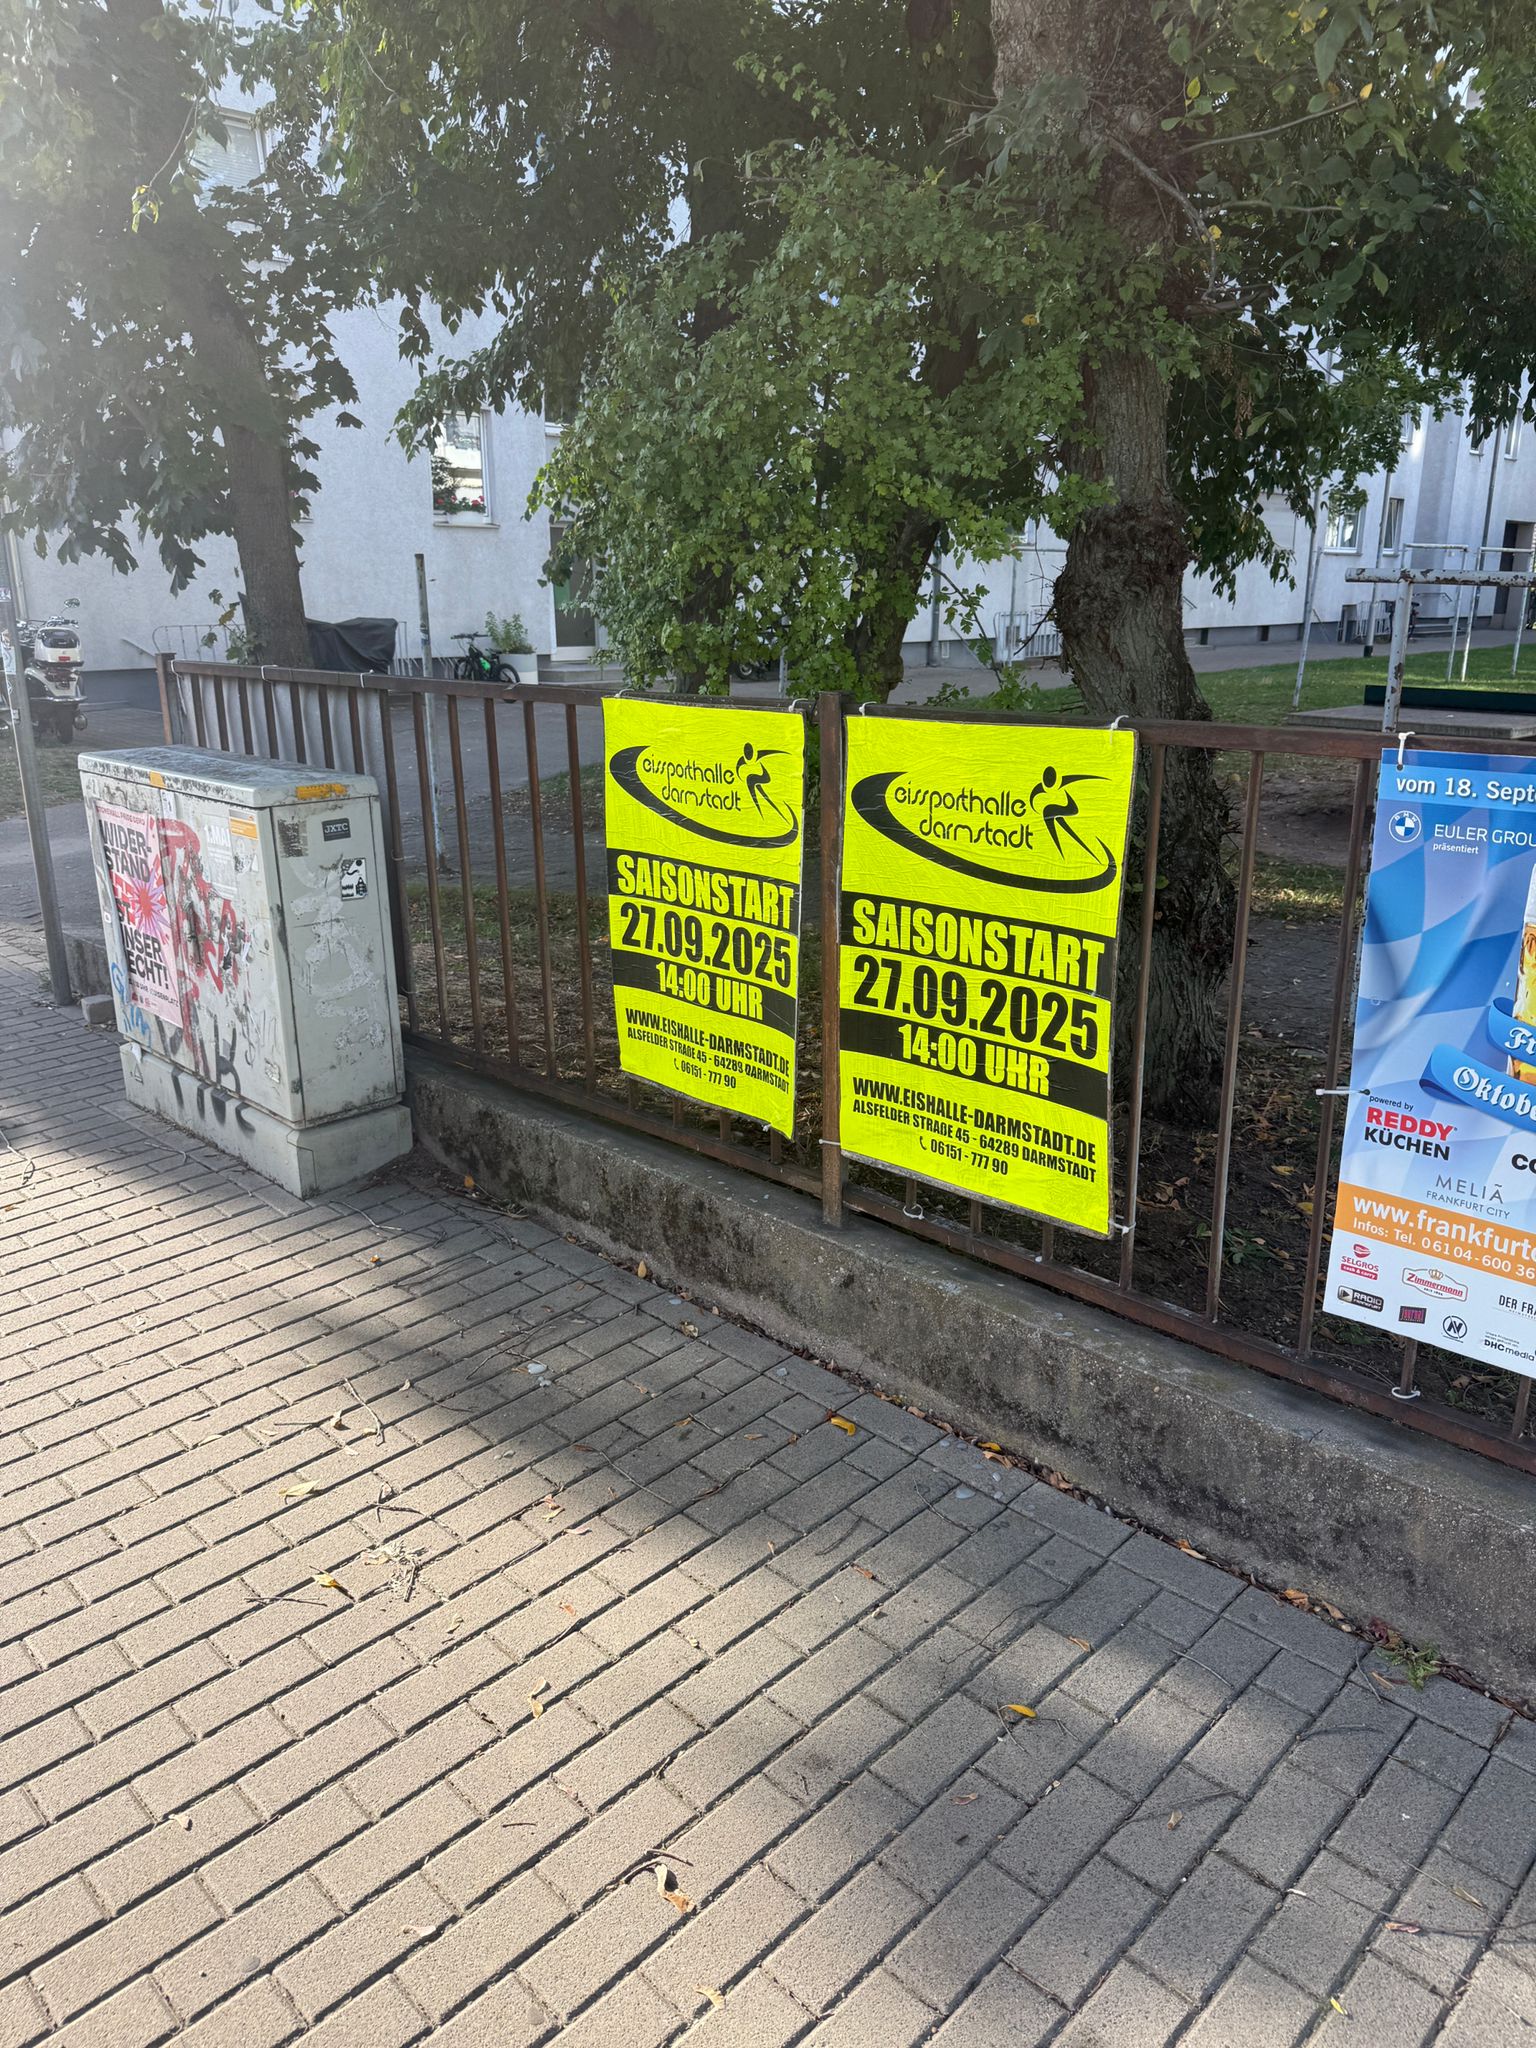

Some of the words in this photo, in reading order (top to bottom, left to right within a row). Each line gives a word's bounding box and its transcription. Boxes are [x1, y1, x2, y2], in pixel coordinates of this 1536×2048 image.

[642, 754, 735, 786] eissporthalle
[662, 783, 741, 811] darmstadt
[894, 781, 1027, 818] eissporthalle
[1396, 777, 1436, 795] vom
[1445, 777, 1477, 797] 18.
[1486, 780, 1536, 805] Sept
[98, 819, 152, 858] WIDER-
[324, 822, 349, 833] JXTC
[919, 813, 1033, 850] darmstadt
[1434, 824, 1488, 841] EULER
[1491, 829, 1536, 847] GROU
[104, 845, 150, 883] STAND
[1433, 842, 1479, 854] präsentiert
[617, 854, 794, 929] SAISONSTART
[115, 898, 131, 925] ST
[620, 902, 791, 988] 27.09.2025
[852, 898, 1104, 993] SAISONSTART
[126, 949, 169, 989] ECHT!
[656, 961, 710, 1005] 14:00
[716, 977, 763, 1020] UHR
[853, 953, 1098, 1060] 27.09.2025
[625, 1008, 789, 1078] WWW.EISHALLE-DARMSTADT.DE
[627, 1027, 668, 1049] ALSFELDER
[697, 1052, 707, 1064] 45
[714, 1056, 742, 1074] 64289
[744, 1064, 789, 1095] DARMSTADT
[899, 1023, 976, 1077] 14:00
[984, 1043, 1050, 1096] UHR
[681, 1060, 702, 1079] 06151
[708, 1070, 722, 1085] 777
[724, 1075, 736, 1089] 90
[853, 1077, 1096, 1163] WWW.EISHALLE-DARMSTADT.DE
[1369, 1095, 1402, 1108] powered
[1404, 1100, 1414, 1111] by
[853, 1099, 910, 1125] ALSFELDER
[955, 1128, 970, 1144] 45
[979, 1135, 1019, 1158] 64289
[1022, 1146, 1096, 1182] DARMSTADT
[1366, 1106, 1453, 1141] REDDY
[930, 1138, 962, 1161] 06151
[971, 1151, 989, 1170] 777
[992, 1158, 1008, 1176] 90
[1364, 1127, 1450, 1161] KÜCHEN
[1426, 1191, 1483, 1213] FRANKFURT
[1486, 1207, 1510, 1219] CITY
[1341, 1256, 1379, 1272] SELGROS
[1353, 1218, 1389, 1237] Infos:
[1394, 1229, 1416, 1245] Tel.
[1515, 1264, 1536, 1280] 36
[1353, 1292, 1382, 1305] RADIO
[1407, 1272, 1463, 1297] Zimmermann
[1498, 1294, 1518, 1310] DER
[1521, 1301, 1536, 1316] FR
